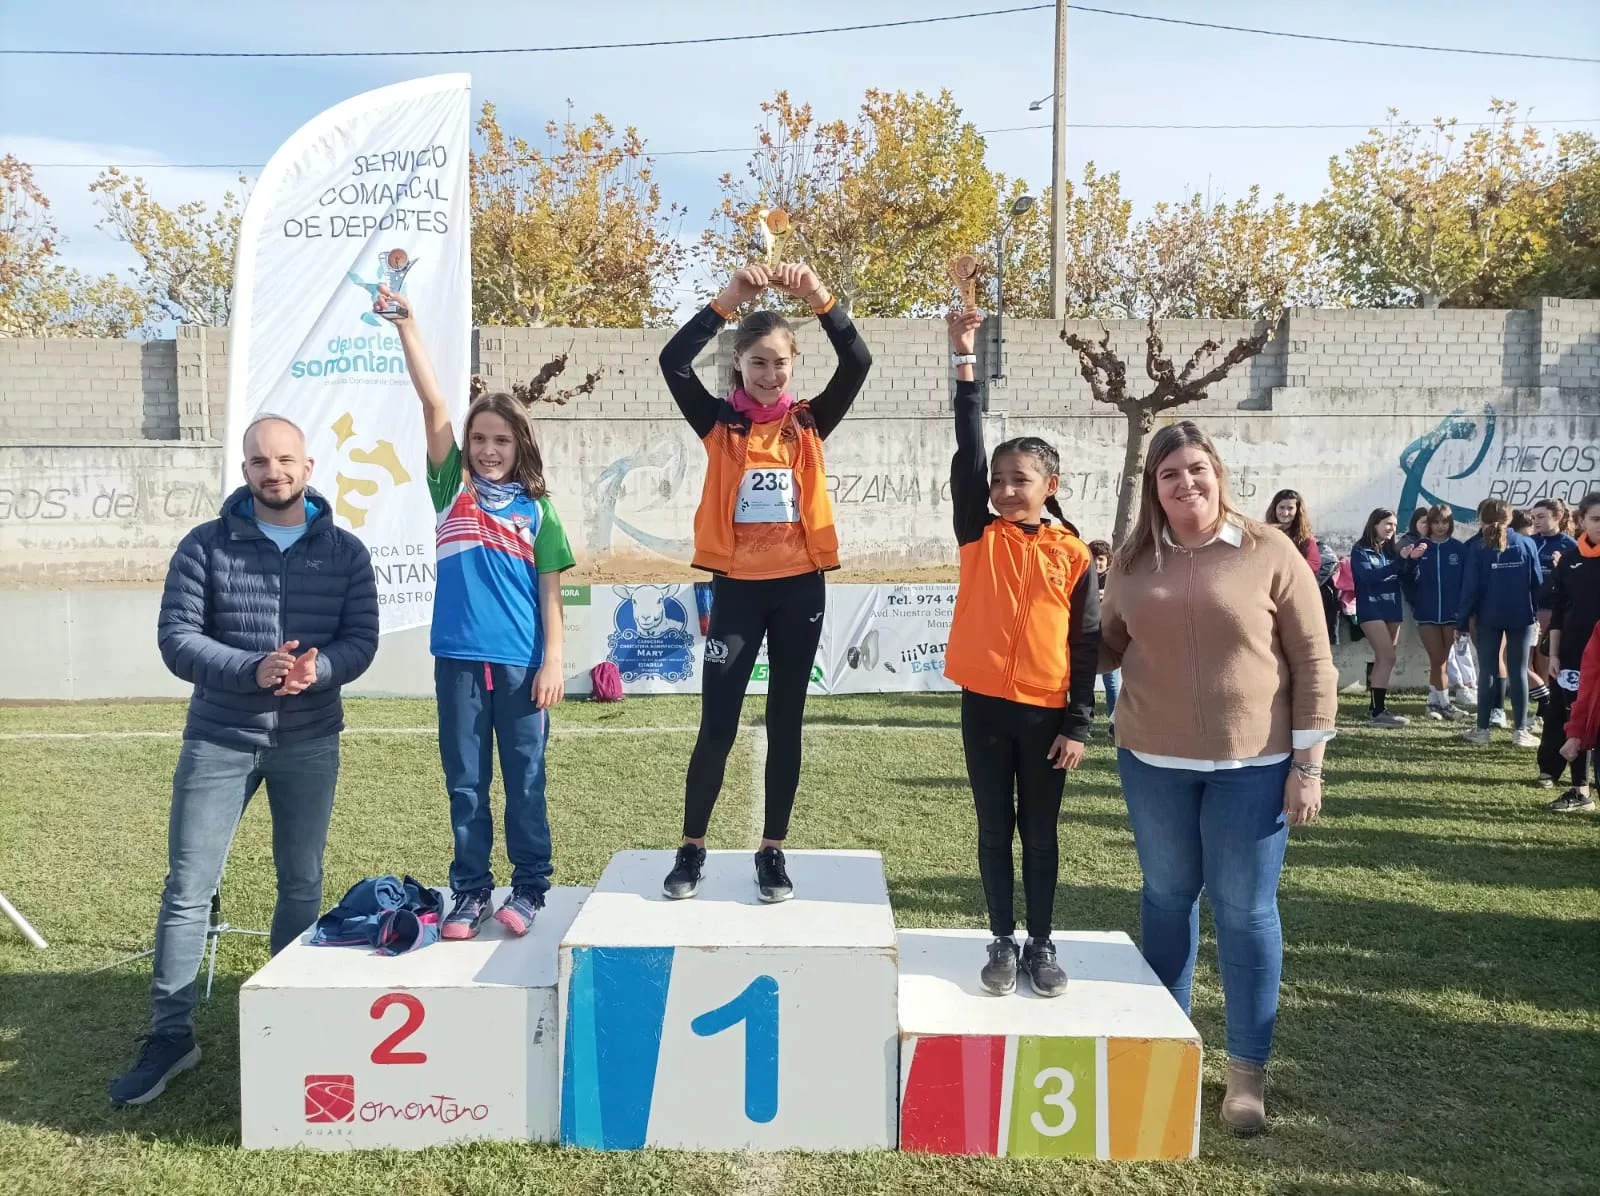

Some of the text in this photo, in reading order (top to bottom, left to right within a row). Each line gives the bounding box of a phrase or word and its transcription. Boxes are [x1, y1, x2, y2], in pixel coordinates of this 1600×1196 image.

[352, 145, 447, 176] SERVICIO
[319, 176, 448, 206] COMARCAL
[284, 209, 448, 238] DE DEPORTES
[291, 350, 407, 378] somontan
[1496, 446, 1599, 472] RIEGOS
[825, 474, 922, 503] RZANA
[0, 488, 71, 519] GOS
[164, 487, 220, 517] CIN
[370, 544, 424, 557] RCA DE
[375, 563, 436, 585] NTAN
[379, 591, 433, 605] BASTRO
[888, 594, 957, 605] Tel. 974 4
[893, 609, 930, 617] Nuestra
[934, 608, 953, 617] Señ
[927, 620, 952, 628] Monz
[637, 649, 664, 657] MARY
[757, 667, 769, 679] 5
[911, 659, 945, 674] Esta
[369, 992, 428, 1065] 2
[691, 974, 779, 1124] 1
[1030, 1066, 1077, 1137] 3
